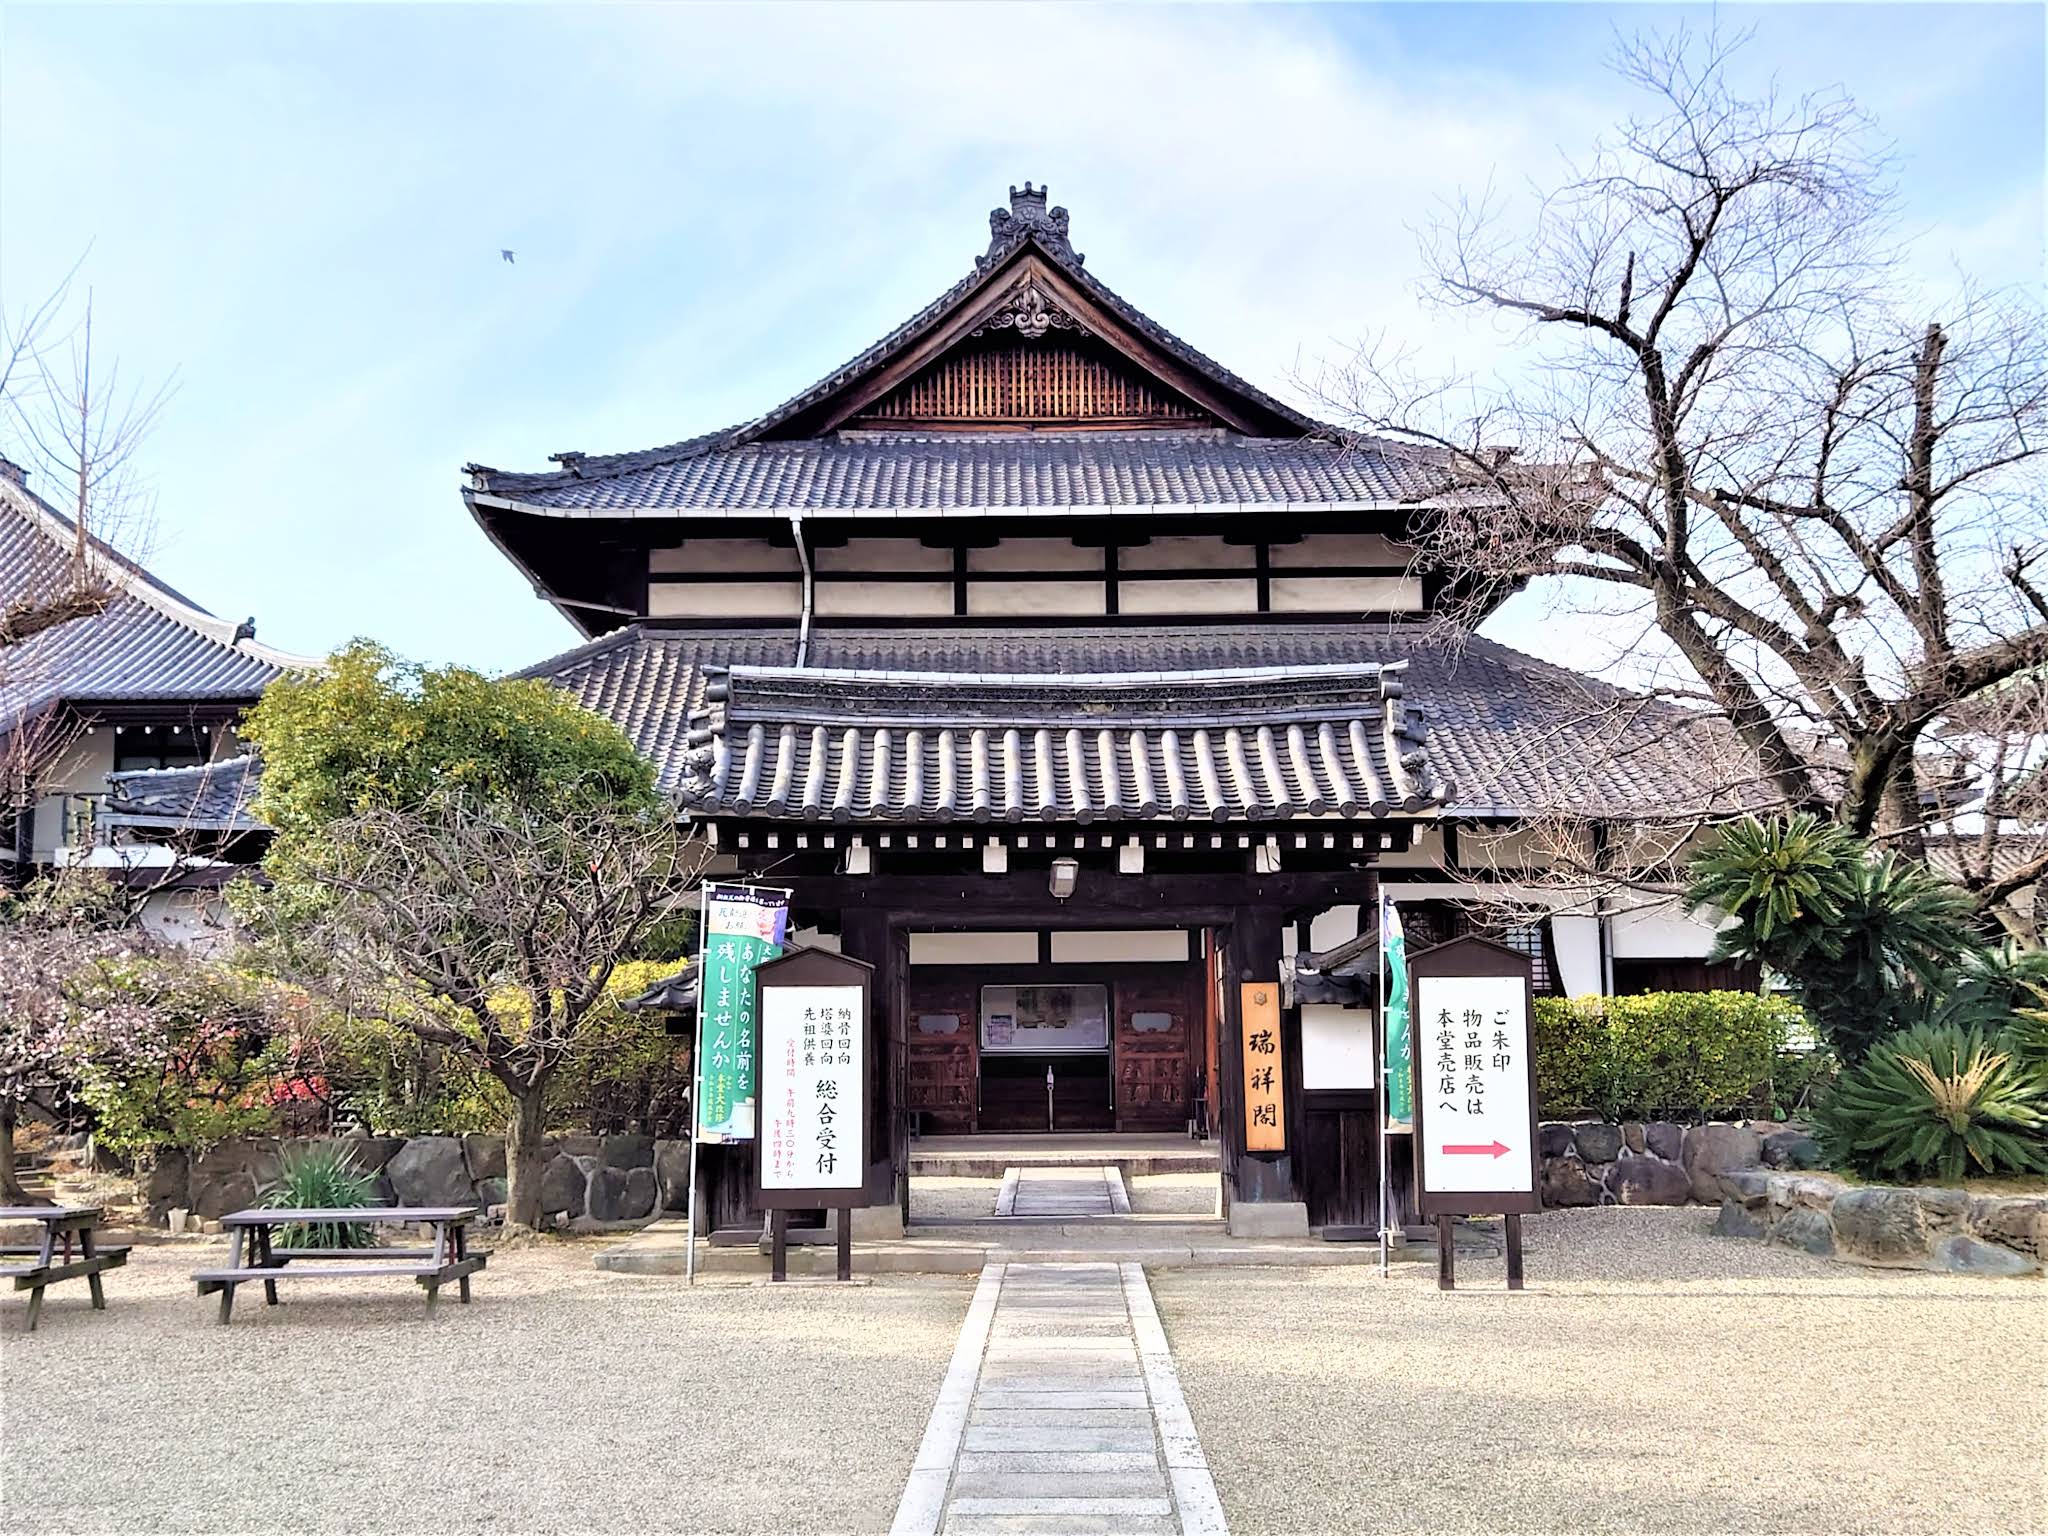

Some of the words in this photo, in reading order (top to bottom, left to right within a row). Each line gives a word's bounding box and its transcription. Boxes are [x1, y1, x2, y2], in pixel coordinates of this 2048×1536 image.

[712, 941, 736, 1069] 残しませんか
[736, 943, 754, 1090] あなたの名前を
[803, 1007, 816, 1067] 先祖供養
[820, 1007, 834, 1065] 塔婆回向
[838, 1007, 851, 1065] 納骨回向
[1492, 1009, 1511, 1072] ご朱印
[1249, 1029, 1276, 1127] 瑞祥閣
[1436, 1008, 1458, 1112] 本堂売店へ
[1463, 1009, 1484, 1115] 物品販売は
[815, 1079, 838, 1175] 総合受付
